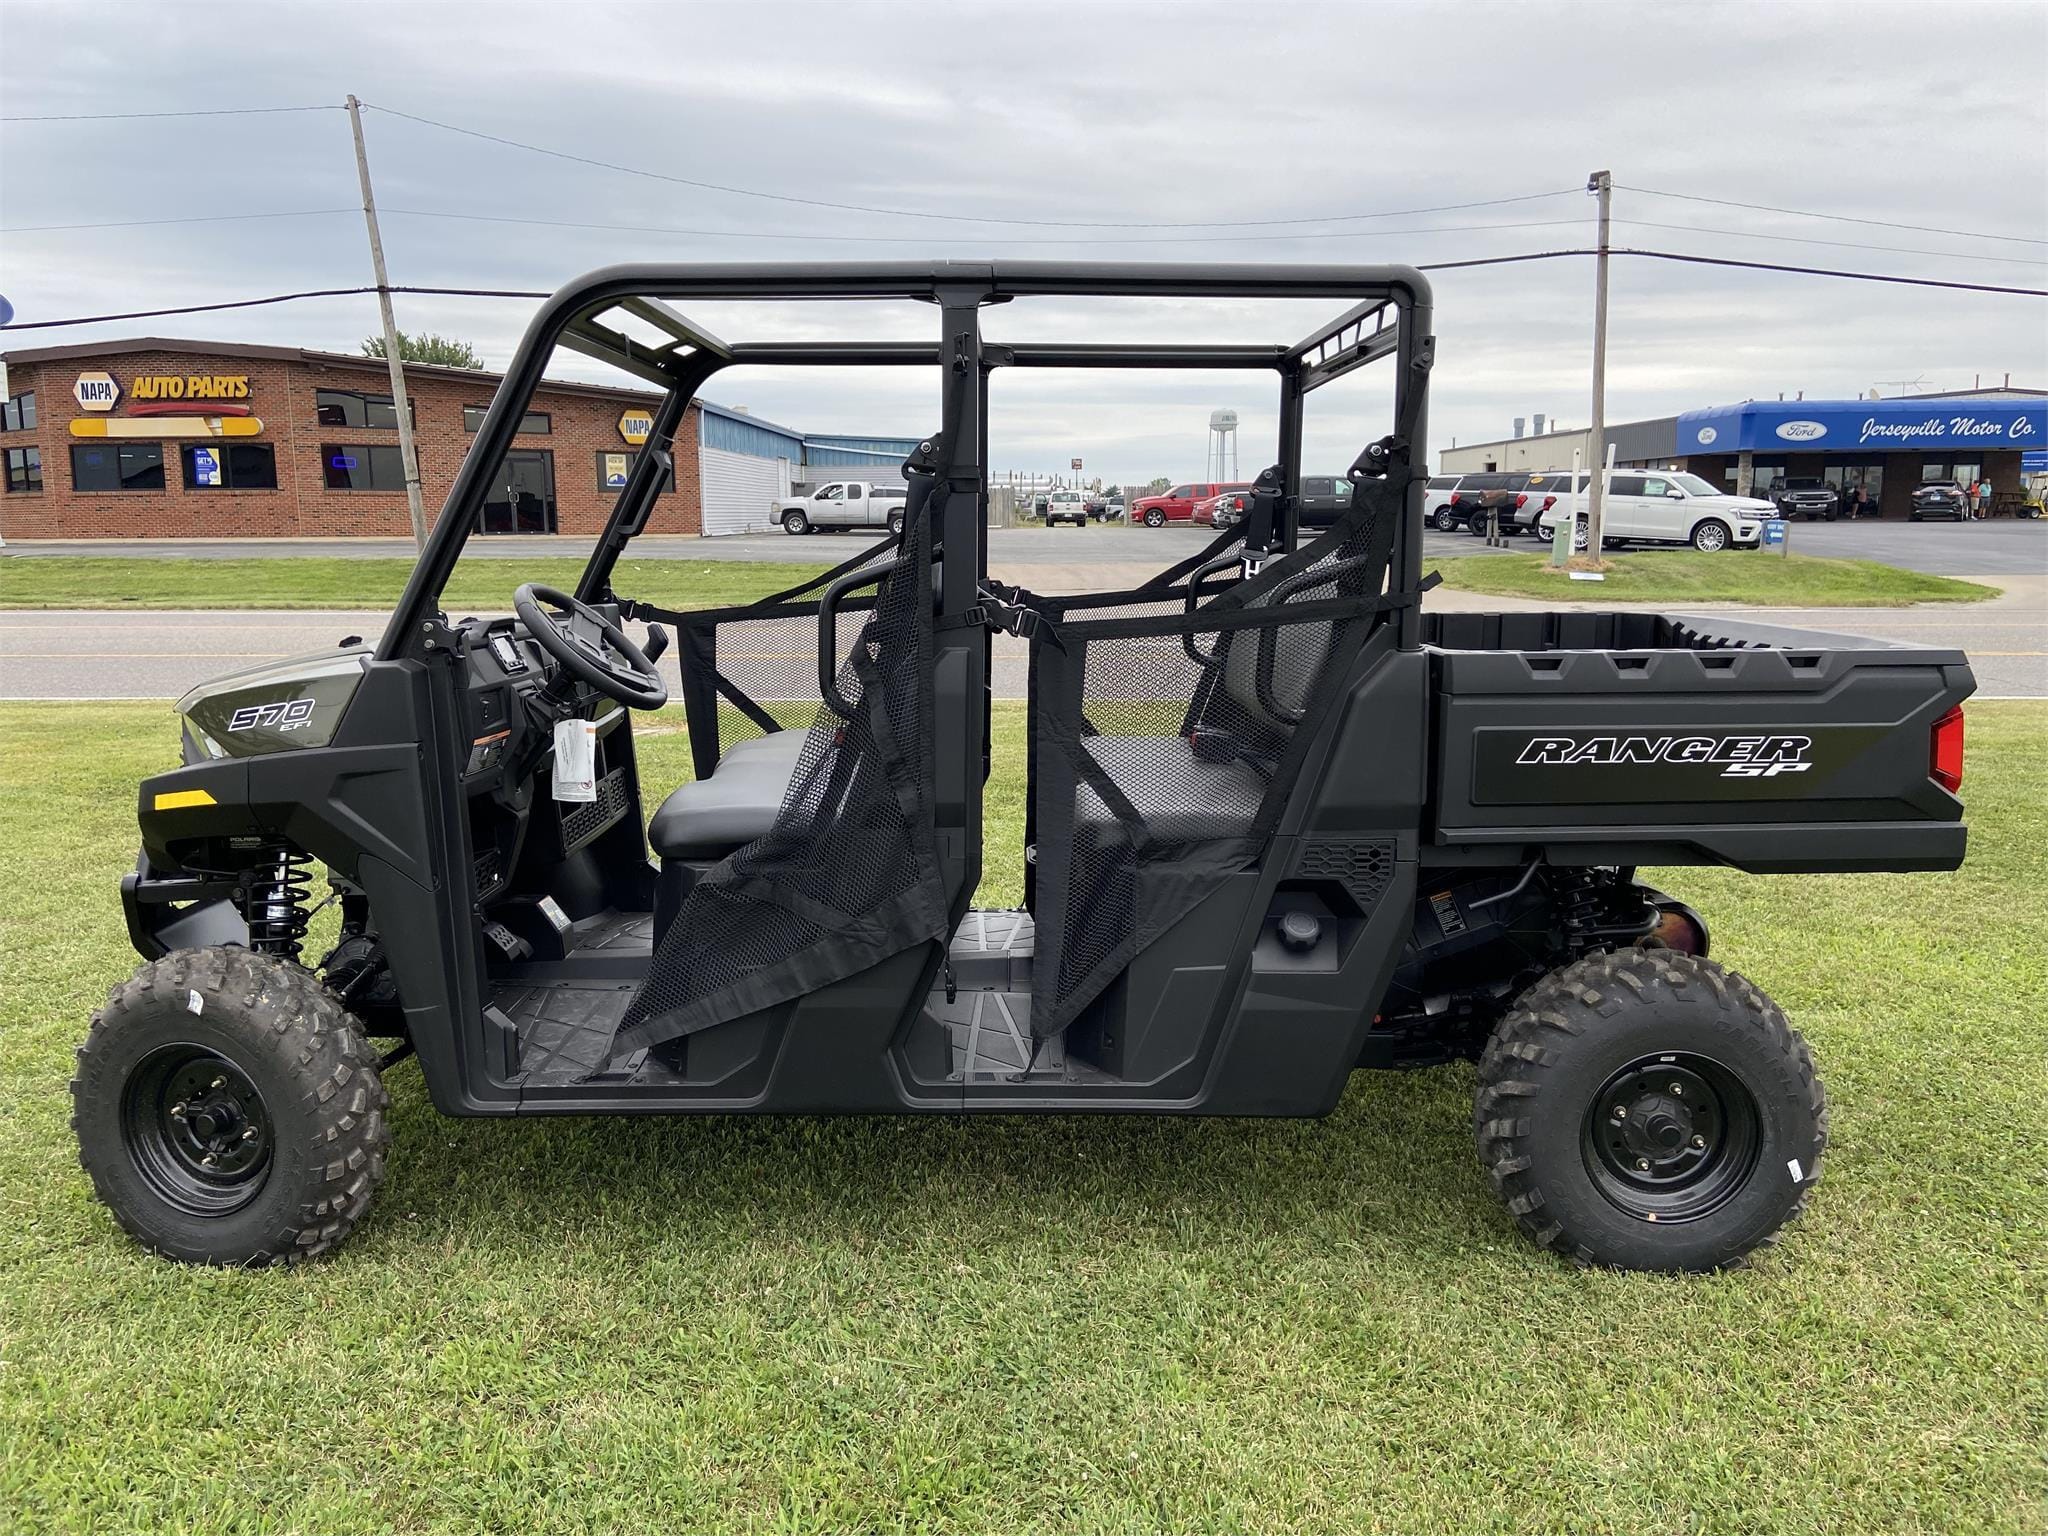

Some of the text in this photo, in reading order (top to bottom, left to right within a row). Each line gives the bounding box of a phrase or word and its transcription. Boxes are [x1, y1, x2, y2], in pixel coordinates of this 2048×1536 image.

[80, 382, 113, 401] NAPA
[131, 375, 250, 399] AUTO PARTS
[625, 418, 651, 434] NAPA
[1786, 424, 1817, 437] Ford
[1859, 416, 2036, 443] Jerseyville Motor Co.
[227, 698, 316, 732] 570
[279, 720, 313, 732] EFI
[1515, 736, 1812, 764] RANGER
[1720, 762, 1813, 777] SP
